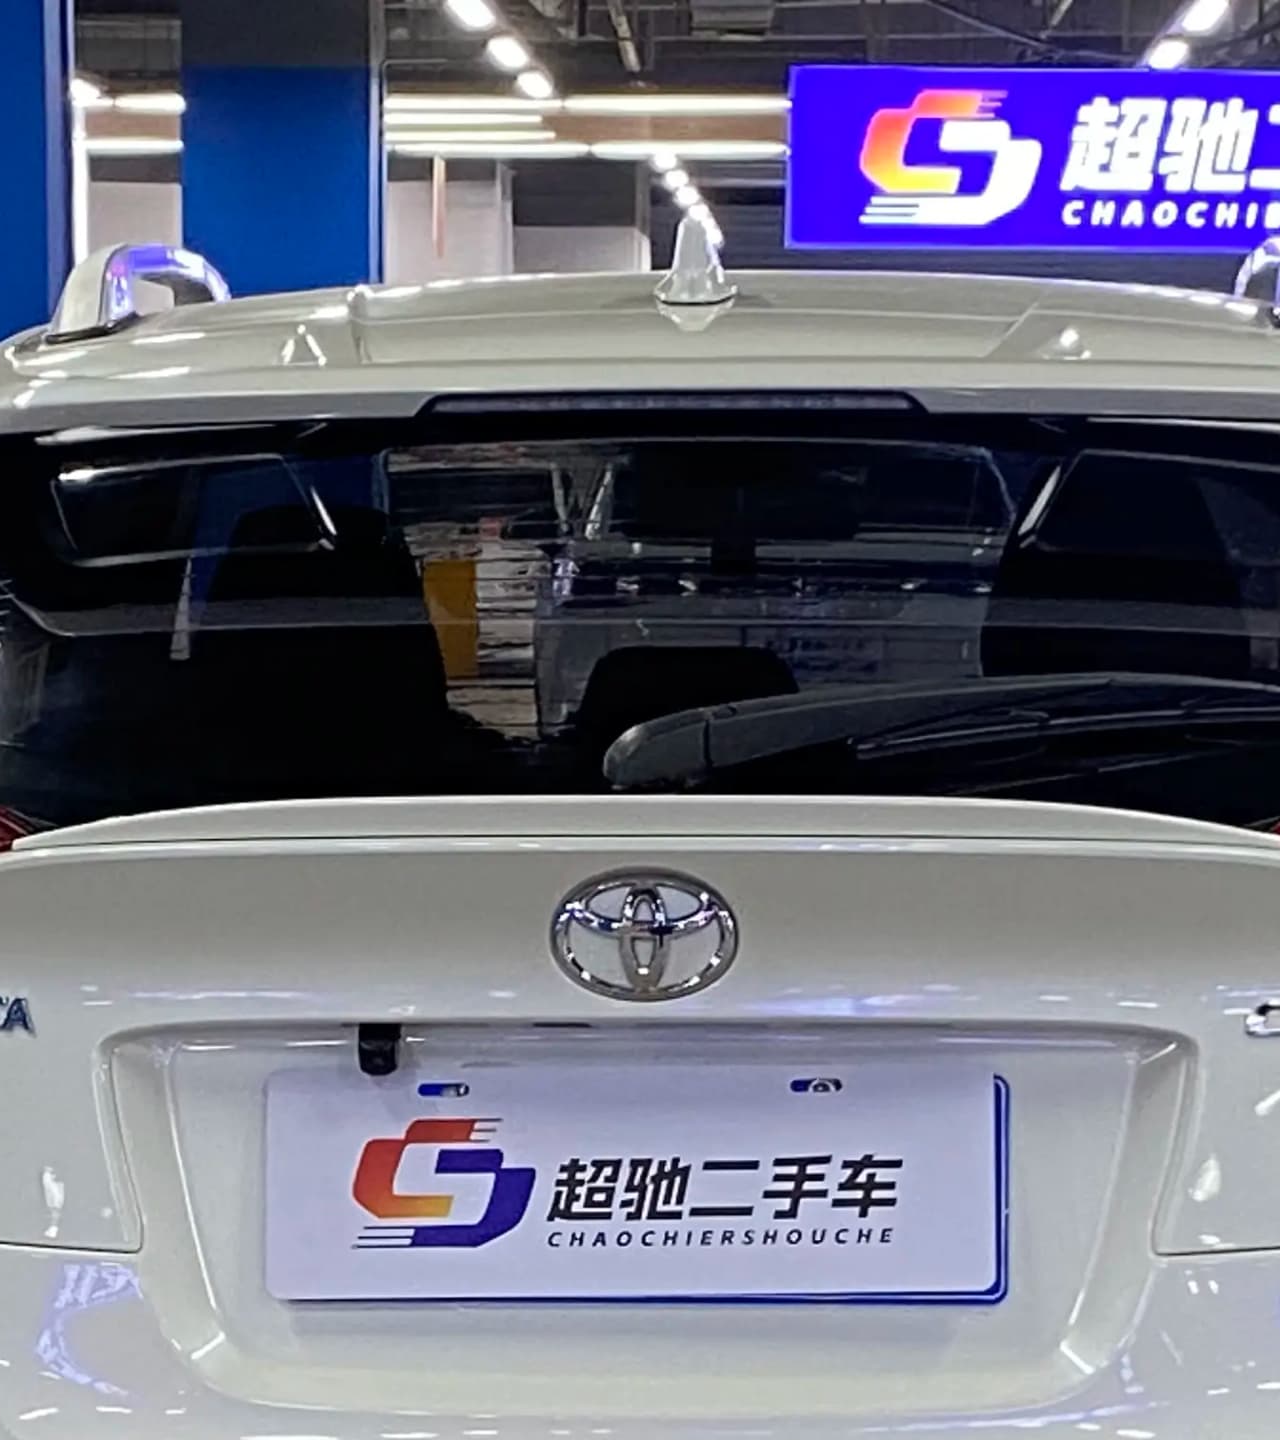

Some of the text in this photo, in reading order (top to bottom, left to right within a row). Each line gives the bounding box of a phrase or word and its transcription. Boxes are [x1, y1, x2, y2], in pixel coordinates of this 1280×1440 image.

[545, 1154, 904, 1224] 超驰二手车
[547, 1227, 895, 1249] CHAOCHIERSHOUCHE
